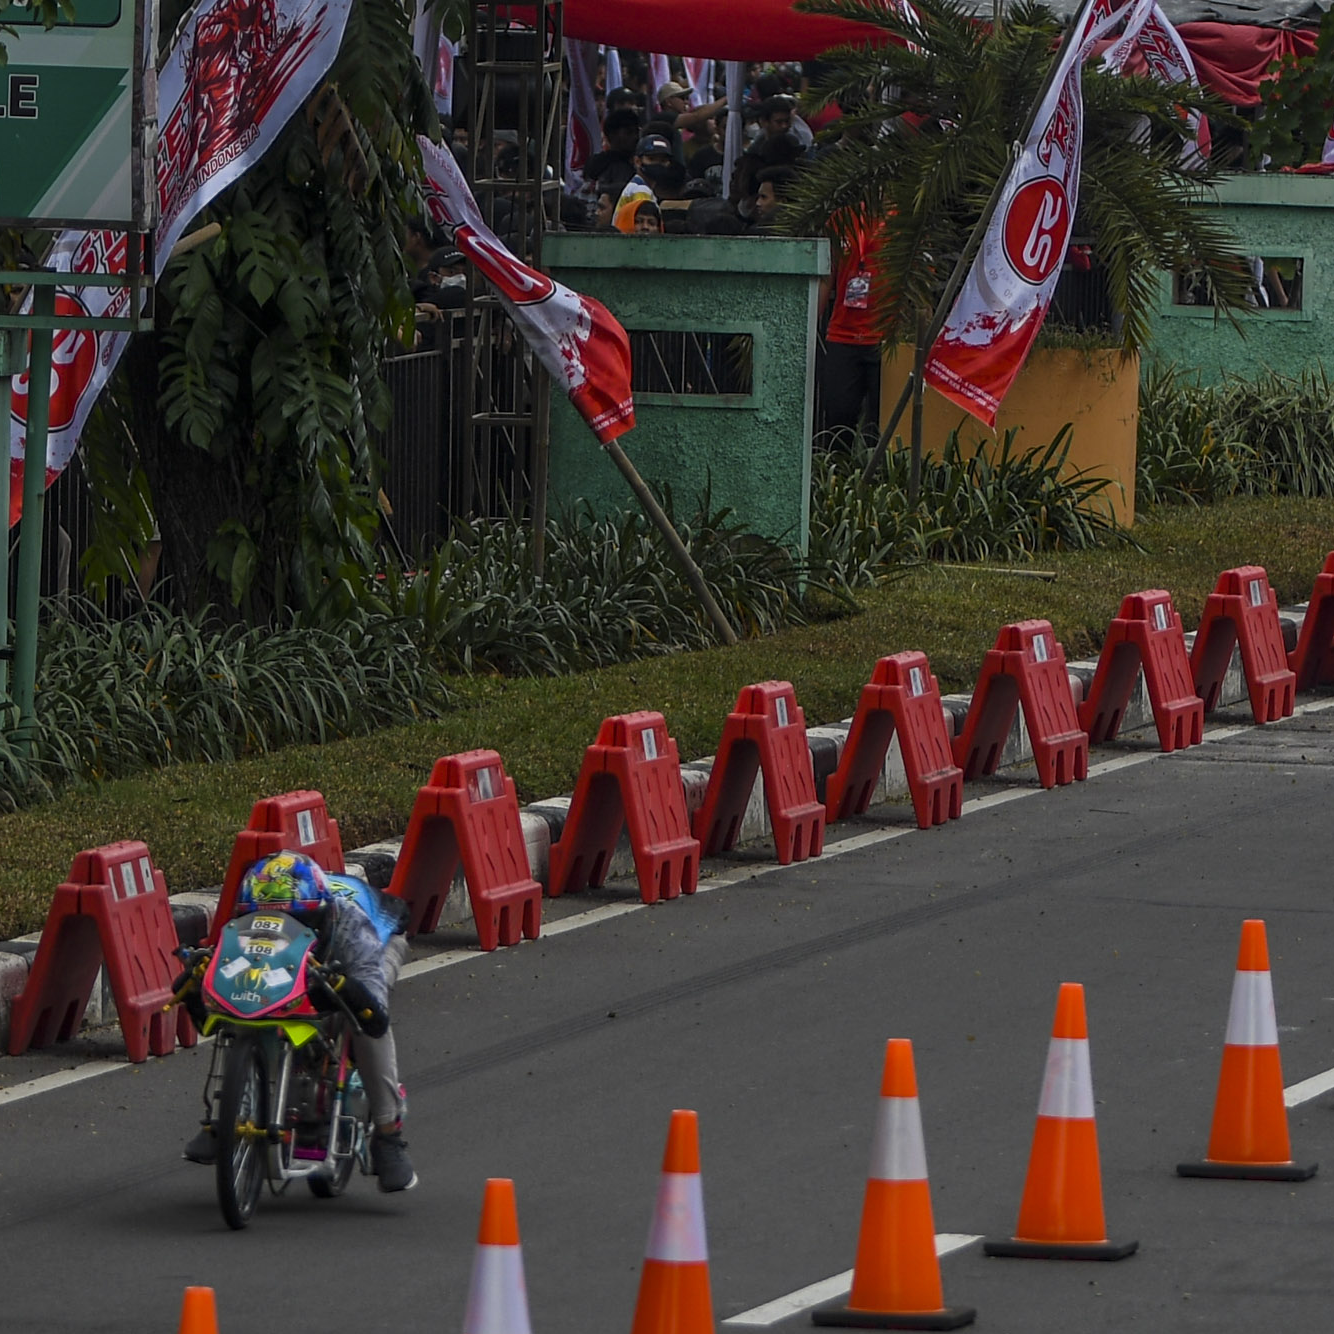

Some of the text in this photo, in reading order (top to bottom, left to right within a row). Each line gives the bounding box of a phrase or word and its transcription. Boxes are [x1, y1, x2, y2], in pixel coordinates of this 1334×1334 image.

[196, 122, 262, 189] INDONESIA
[254, 920, 280, 931] 082
[247, 944, 273, 955] 108
